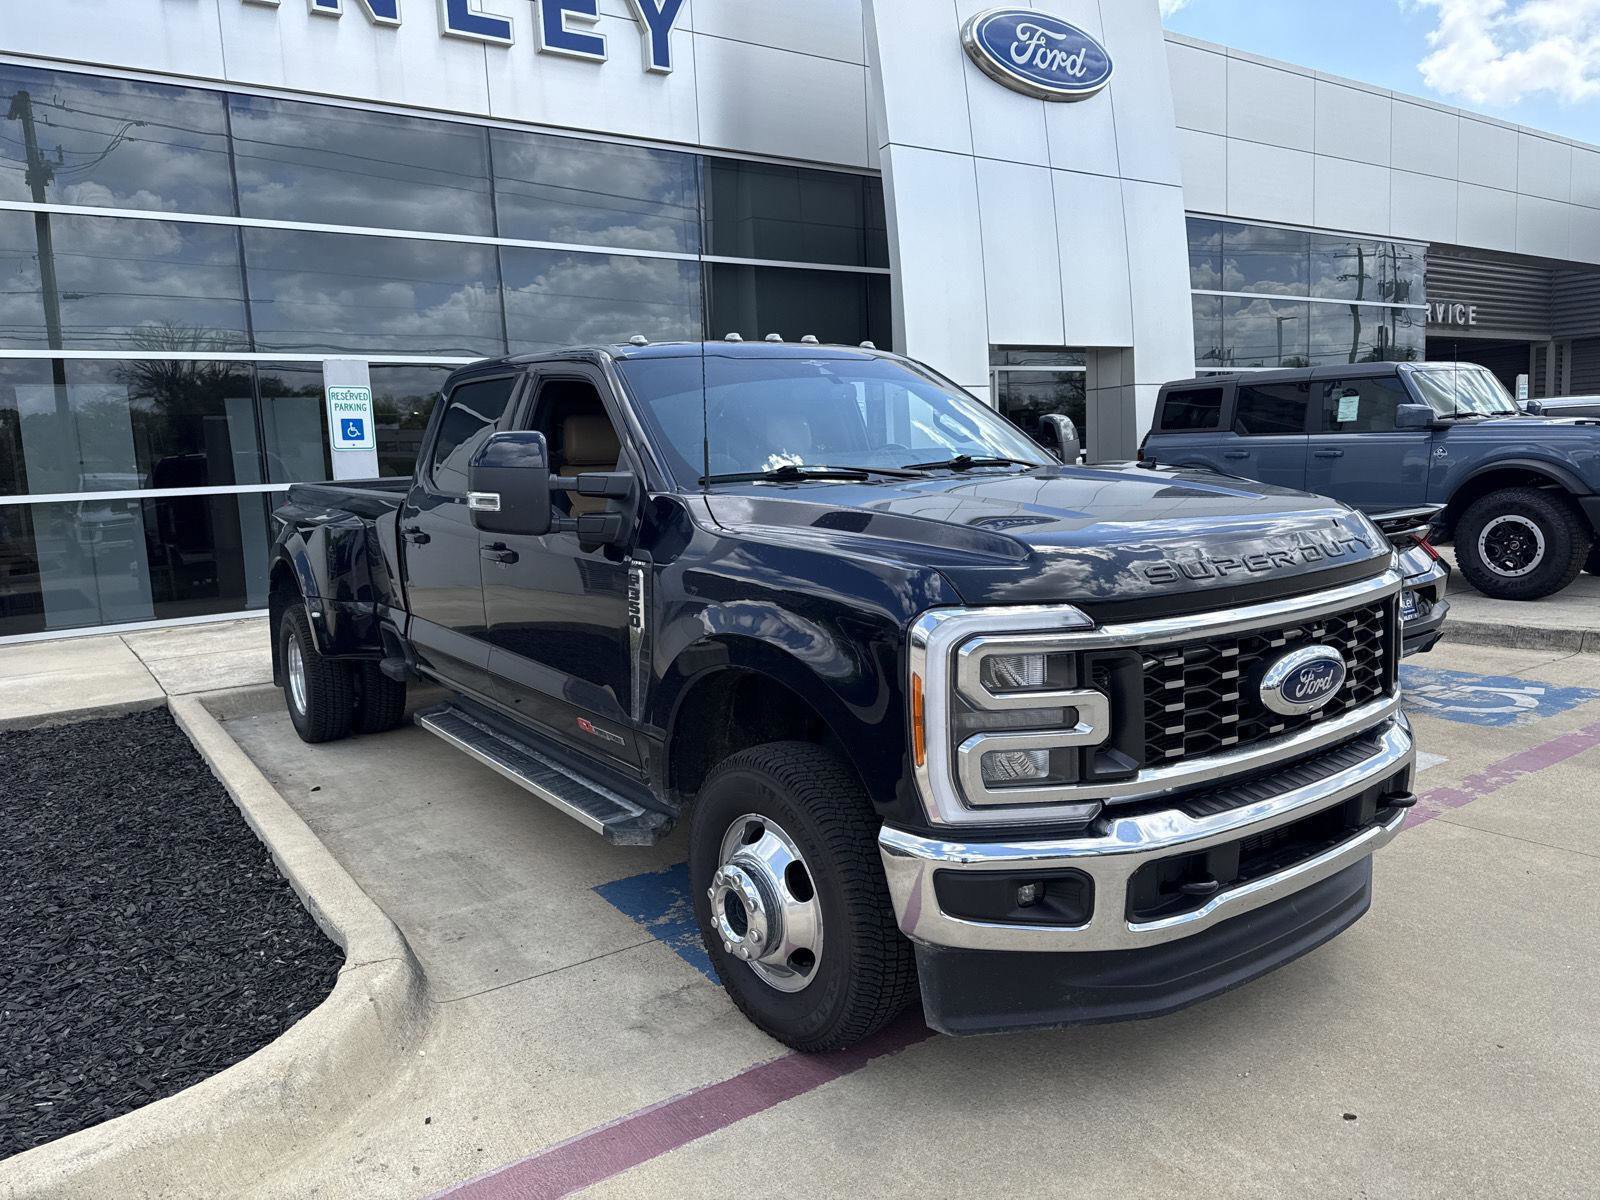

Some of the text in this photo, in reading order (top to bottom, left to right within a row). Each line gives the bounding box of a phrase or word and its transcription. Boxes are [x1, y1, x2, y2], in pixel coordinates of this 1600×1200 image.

[239, 0, 688, 74] LEY
[1010, 22, 1087, 78] Ford
[331, 392, 368, 401] RESERVED
[334, 403, 367, 412] PARKING
[1144, 533, 1372, 585] SUPER DUTY
[1295, 665, 1334, 698] Ford
